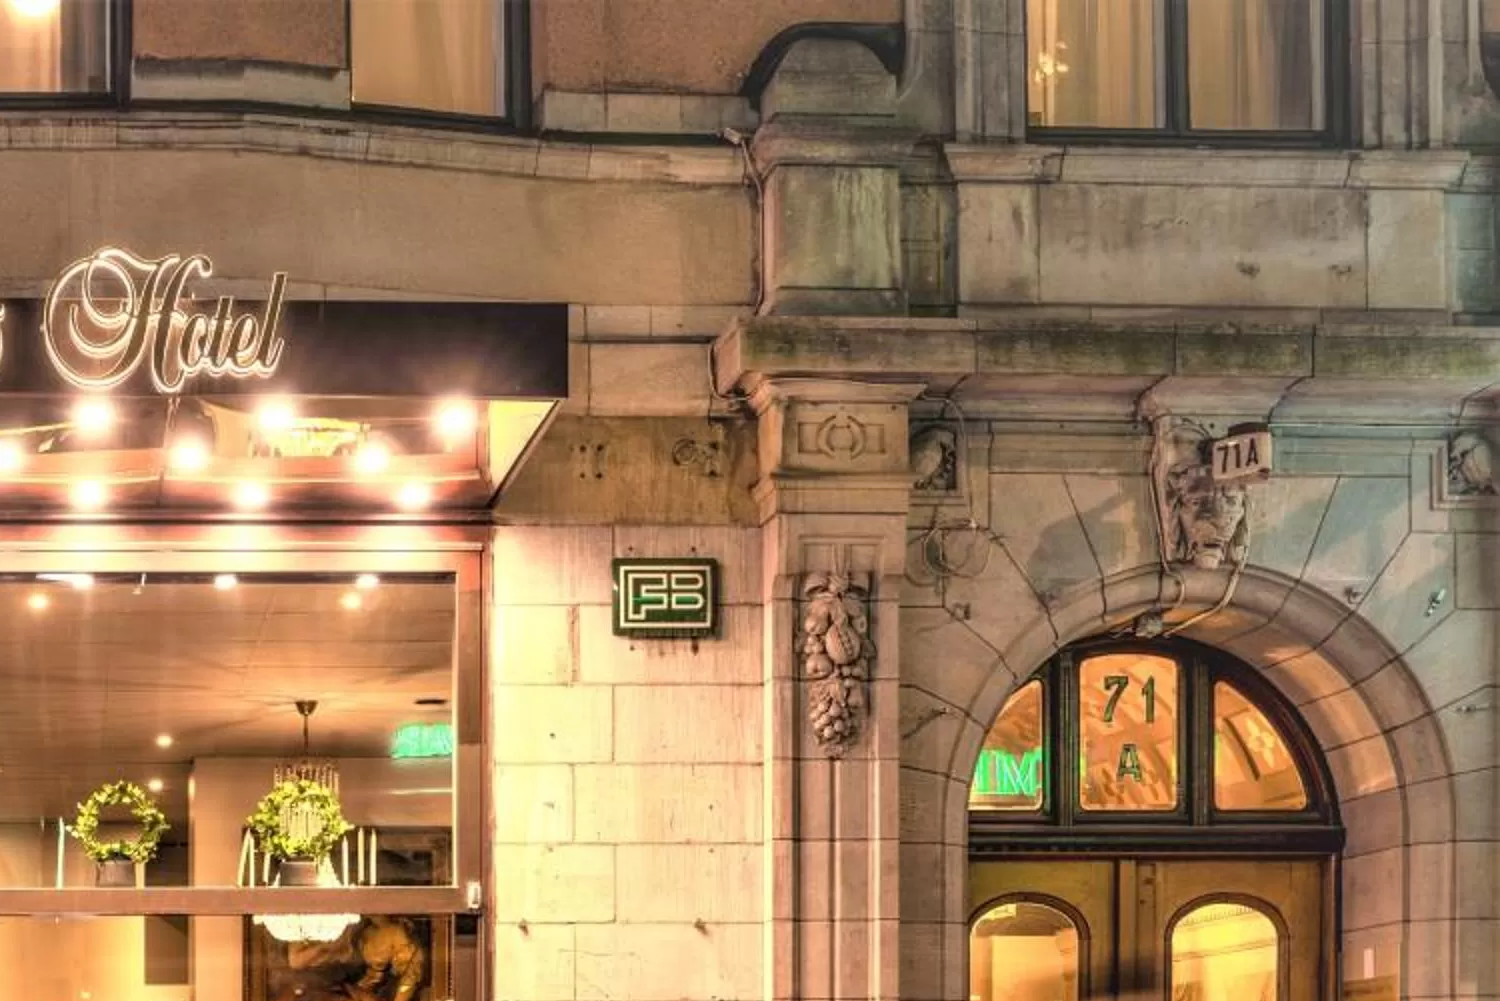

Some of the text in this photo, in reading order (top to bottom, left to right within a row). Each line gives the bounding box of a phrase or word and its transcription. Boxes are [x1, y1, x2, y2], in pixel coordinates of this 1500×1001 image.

[41, 247, 289, 393] Hotel
[1216, 437, 1259, 475] 71A
[1103, 674, 1155, 724] 71
[1116, 742, 1142, 783] A
